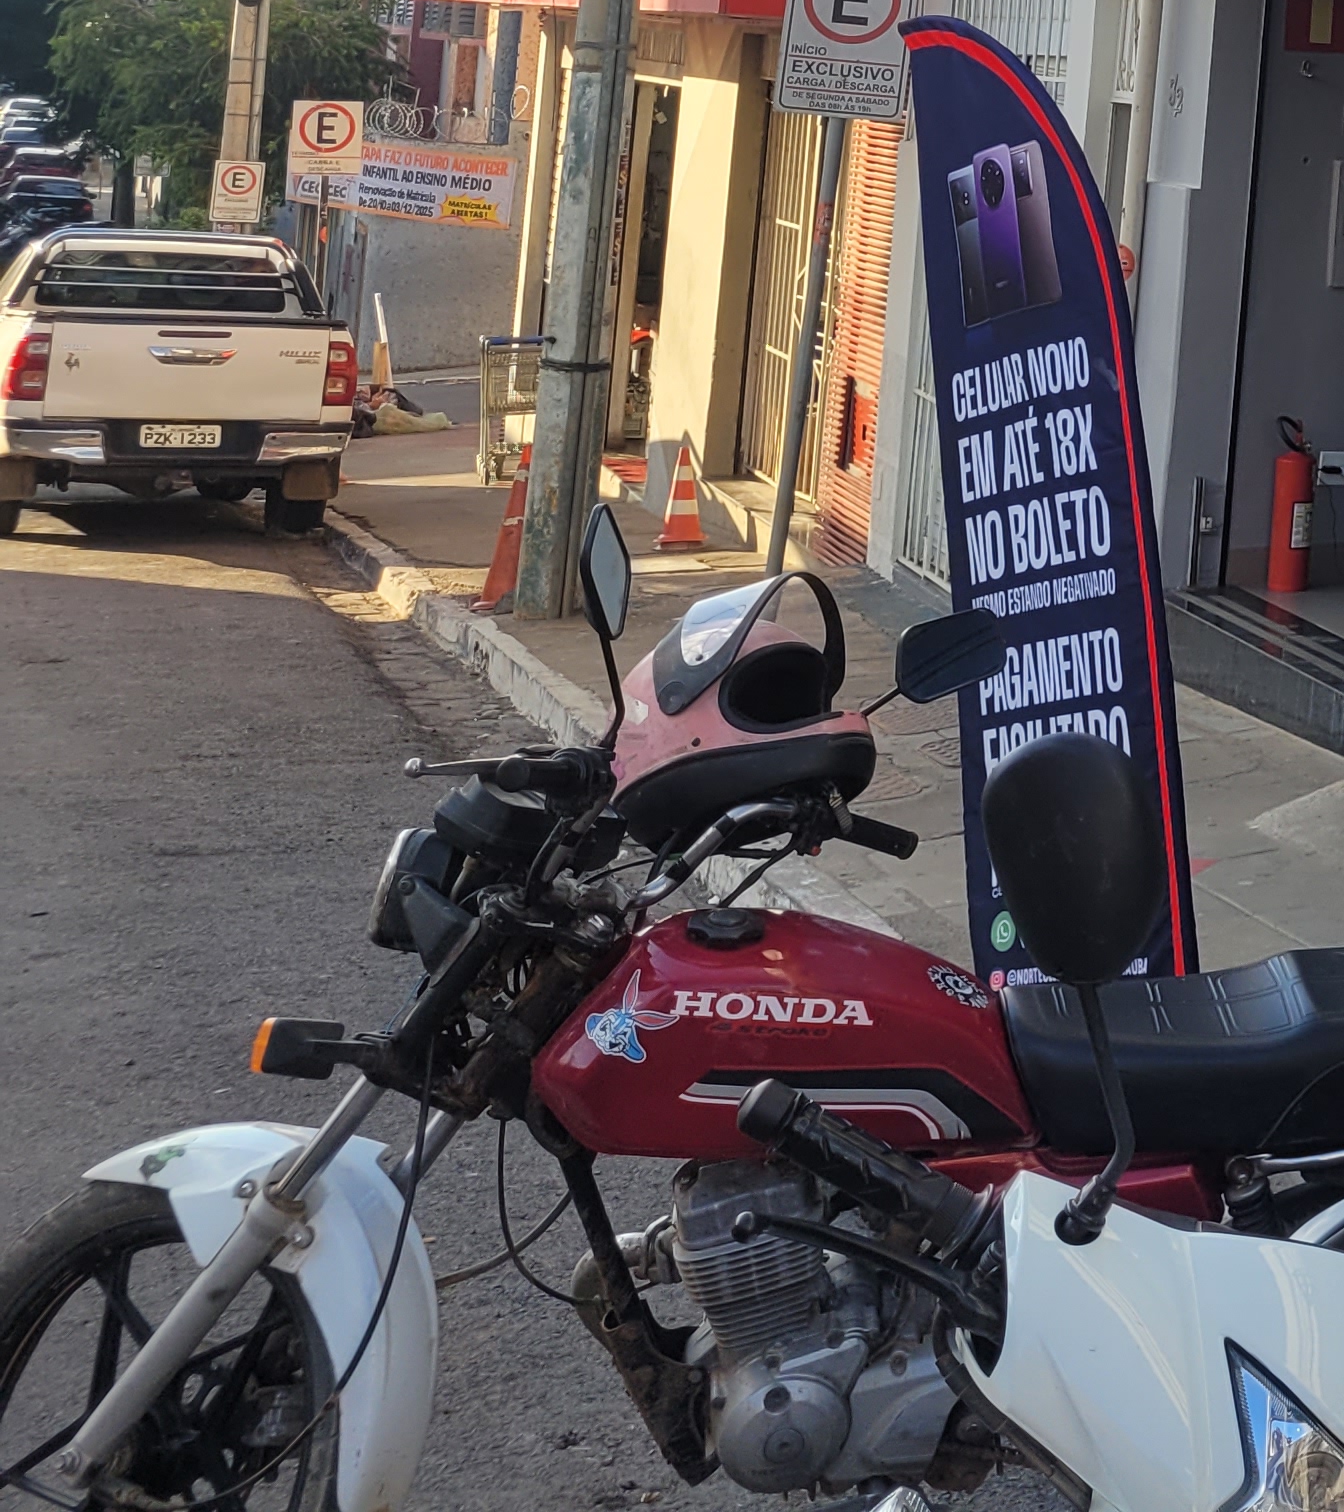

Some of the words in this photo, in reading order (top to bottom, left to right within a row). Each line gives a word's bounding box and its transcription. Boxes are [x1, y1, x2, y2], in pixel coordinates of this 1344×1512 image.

[791, 44, 828, 56] INÍCIO
[791, 60, 895, 82] EXCLUSIVO
[786, 76, 826, 88] CARGA
[834, 80, 896, 94] DESCARGA
[792, 91, 804, 99] DE
[806, 92, 846, 102] SEGUNDA
[857, 104, 871, 113] 19h
[317, 112, 338, 144] E
[383, 149, 401, 167] FAZ
[404, 153, 412, 167] O
[414, 154, 449, 171] FUTURO
[232, 172, 245, 188] E
[362, 164, 399, 182] INFANTIL
[401, 170, 414, 185] AO
[415, 171, 447, 188] ENSINO
[450, 173, 492, 192] MÉDIO
[358, 182, 396, 197] Renovação
[397, 190, 405, 199] de
[358, 196, 367, 207] De
[951, 352, 1030, 423] CELULAR
[1026, 336, 1090, 399] NOVO
[957, 429, 998, 504] EM
[1003, 405, 1045, 492] ATÉ
[1044, 403, 1098, 478] 18X
[964, 509, 1006, 586] NO
[1007, 485, 1112, 574] BOLETO
[1007, 580, 1051, 616] ESTANDO
[1053, 568, 1116, 606] NEGATIVADO
[671, 990, 874, 1026] HONDA
